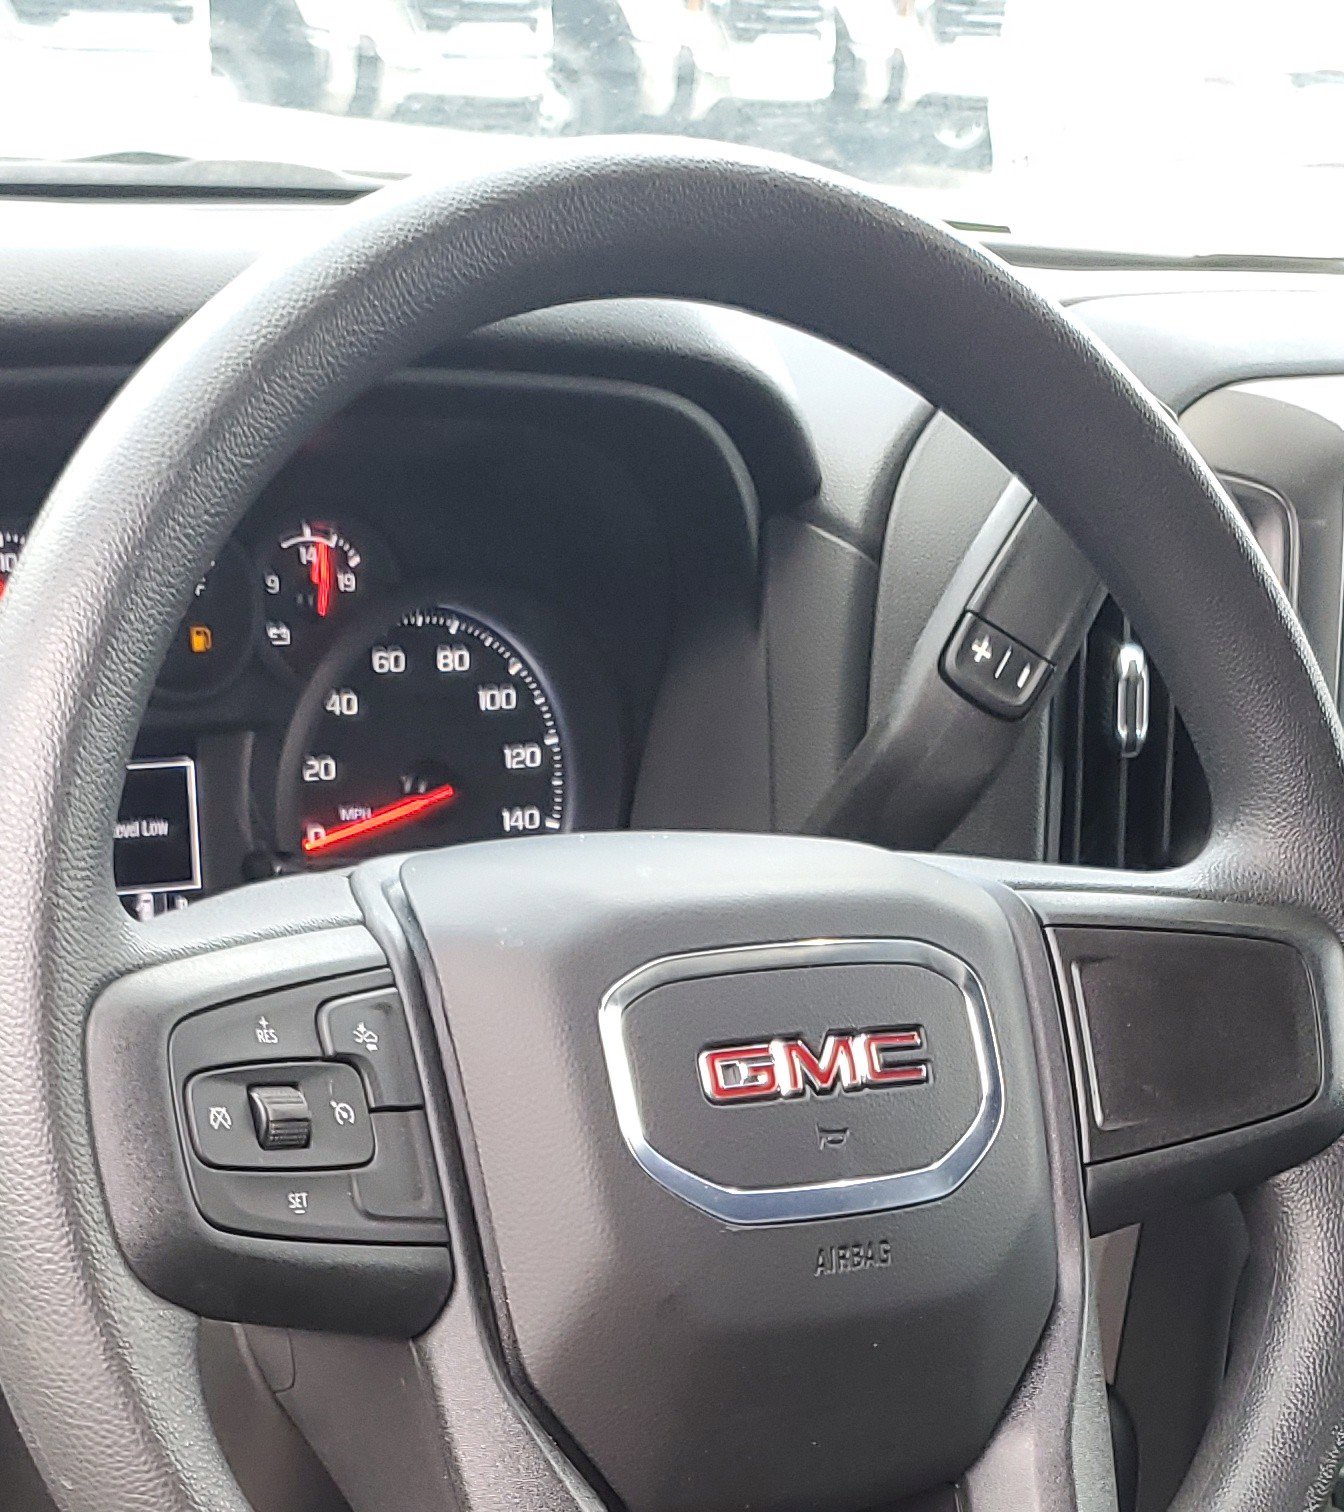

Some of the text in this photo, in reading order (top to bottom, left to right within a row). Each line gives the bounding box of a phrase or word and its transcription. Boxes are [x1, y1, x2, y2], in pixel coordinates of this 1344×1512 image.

[264, 574, 280, 595] 9
[337, 570, 356, 593] 19
[371, 646, 406, 674] 60
[436, 646, 470, 673] 80
[326, 690, 358, 716] 40
[478, 683, 517, 711] 100
[303, 756, 336, 781] 20
[504, 743, 541, 769] 120
[339, 804, 372, 821] MPH
[502, 808, 540, 832] 140
[113, 820, 168, 838] evel Low
[256, 1028, 278, 1044] RES
[697, 1025, 930, 1102] GMC
[288, 1193, 308, 1209] SET
[814, 1240, 892, 1277] AIRBAG
